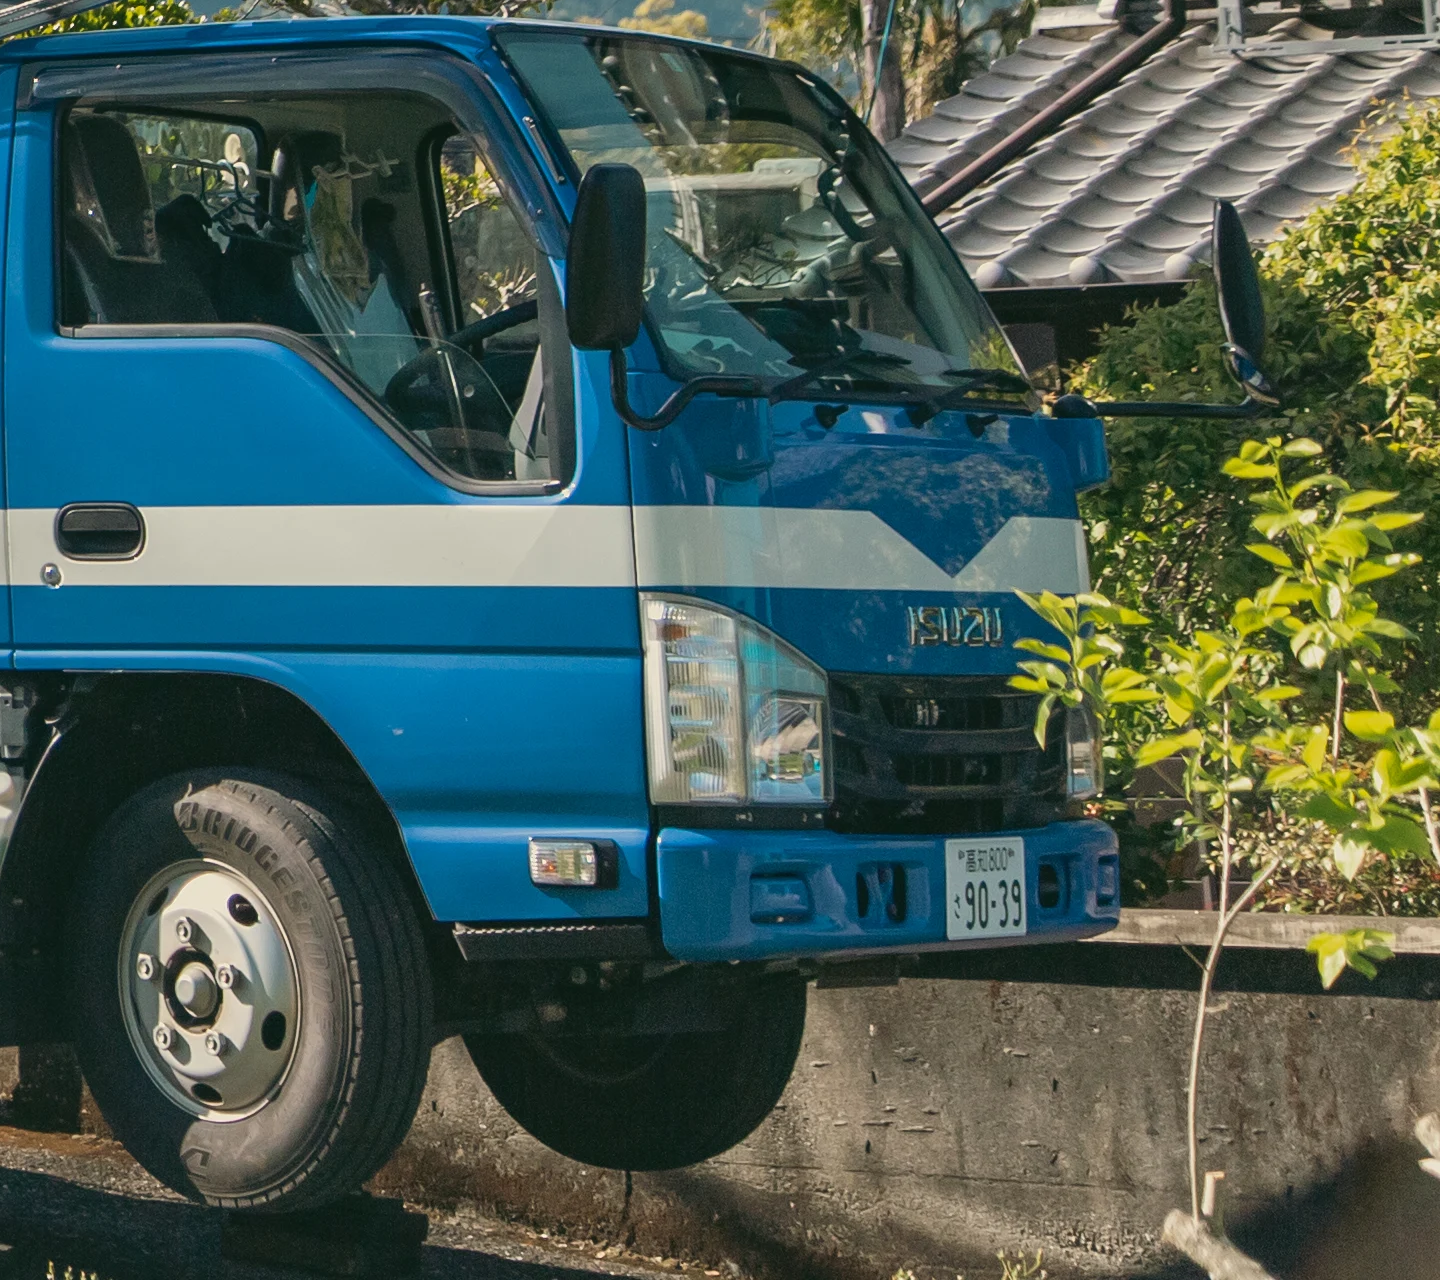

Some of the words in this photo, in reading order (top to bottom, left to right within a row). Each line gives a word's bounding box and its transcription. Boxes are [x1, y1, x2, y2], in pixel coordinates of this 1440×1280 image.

[907, 605, 1003, 647] ISUZU
[966, 847, 1008, 873] 高知800
[965, 880, 1022, 930] 90-39
